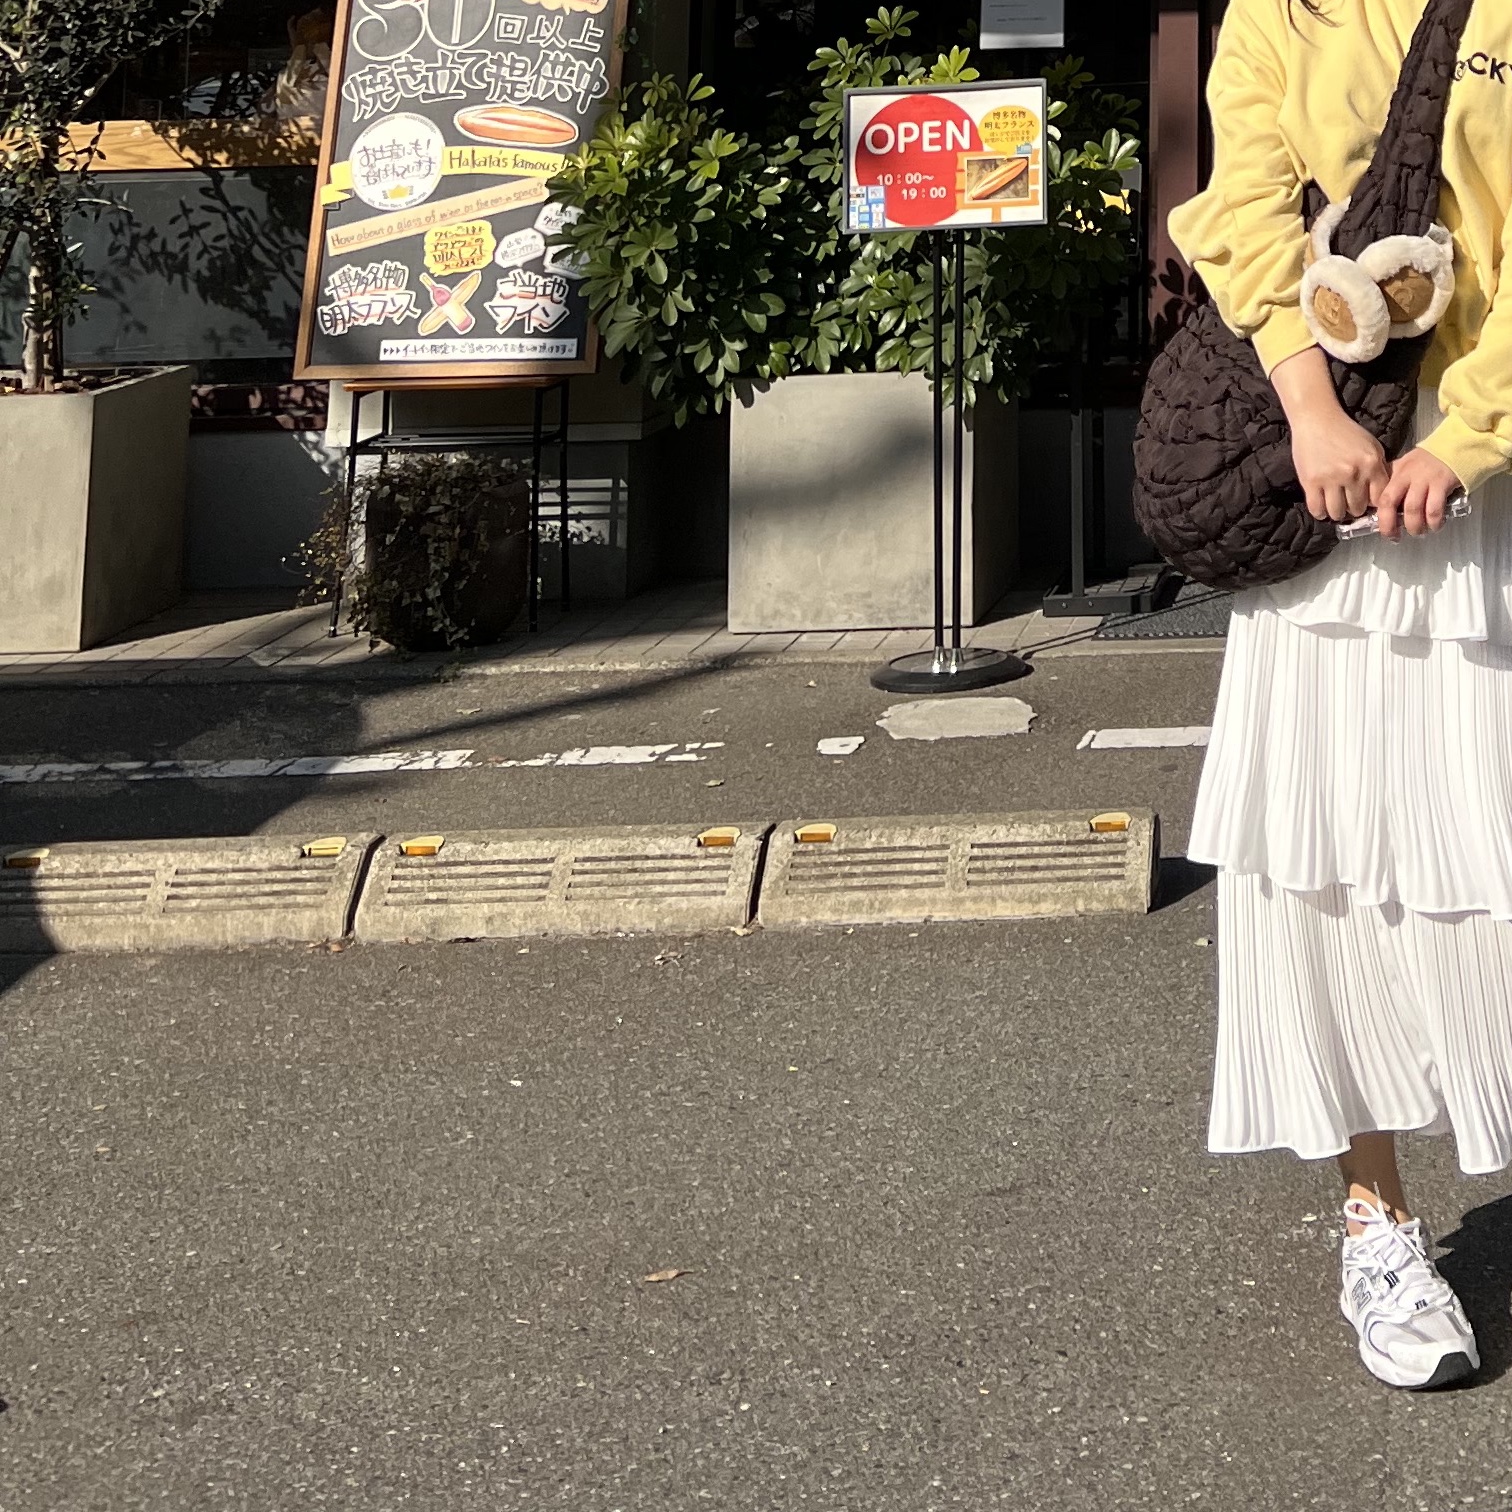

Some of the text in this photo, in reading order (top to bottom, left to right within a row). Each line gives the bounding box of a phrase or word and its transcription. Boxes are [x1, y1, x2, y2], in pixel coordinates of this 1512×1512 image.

[342, 49, 610, 123] 焼き立て提供中
[865, 120, 971, 155] OPEN
[448, 147, 508, 169] Hakata's
[331, 231, 355, 247] How
[356, 223, 385, 241] about
[386, 225, 394, 234] a
[327, 262, 406, 301] 博多名物
[499, 271, 567, 304] ご当地
[320, 292, 418, 333] 明太フランス
[488, 303, 568, 331] ワイン
